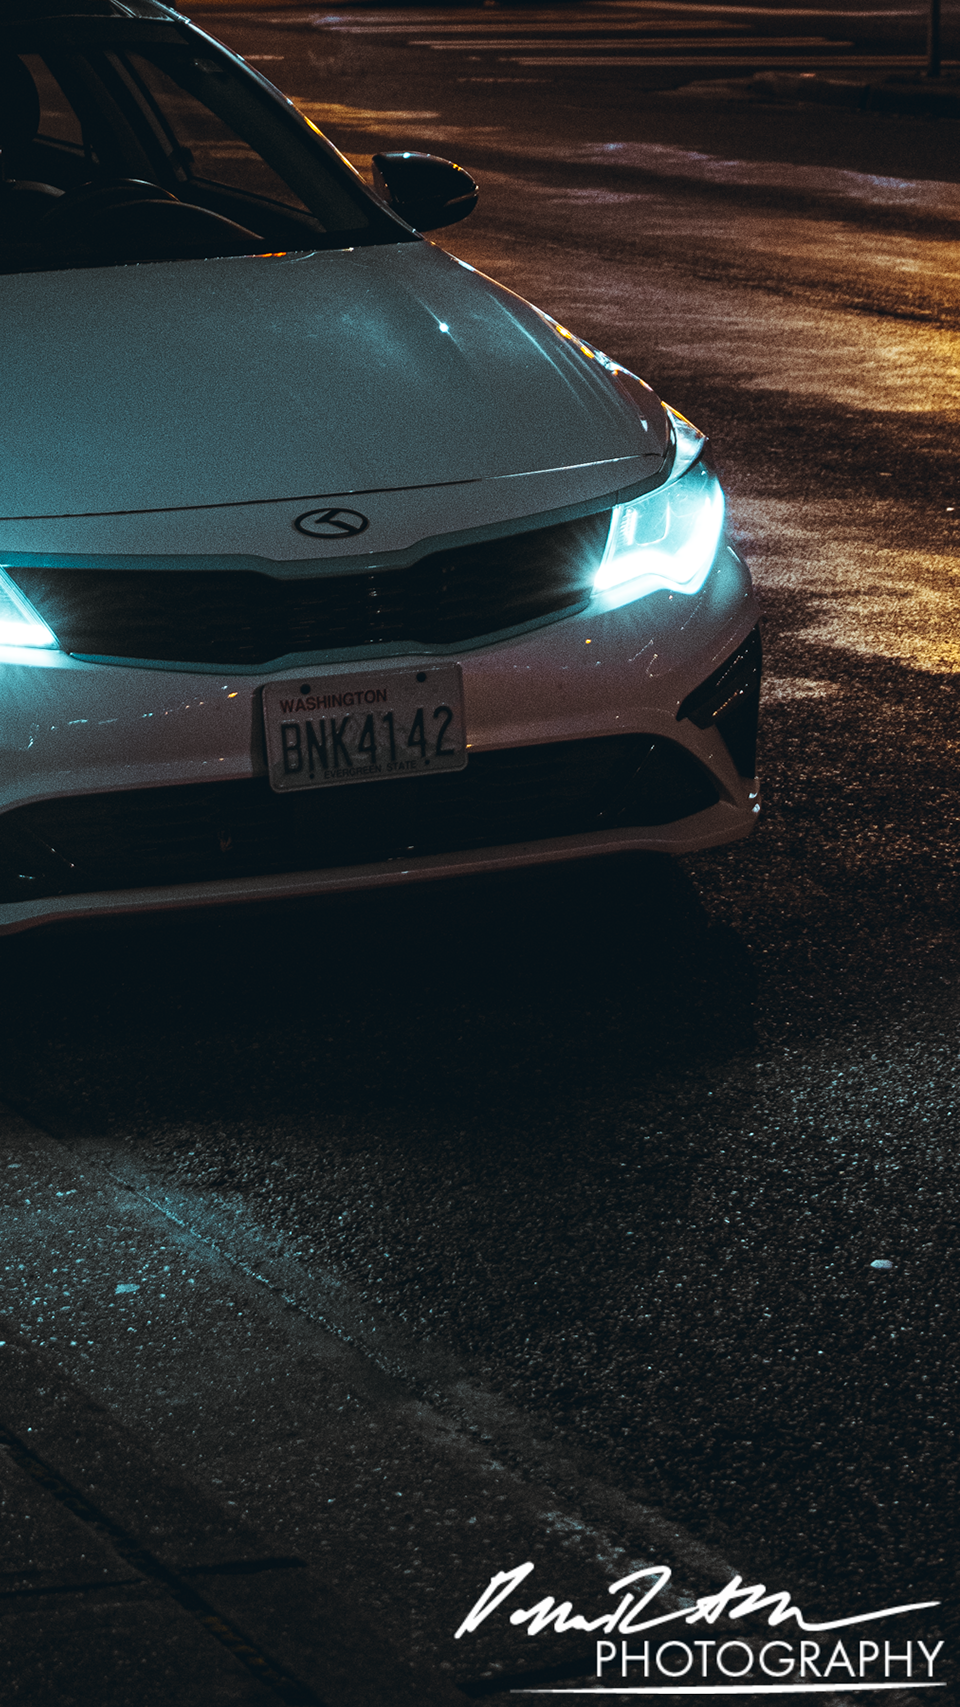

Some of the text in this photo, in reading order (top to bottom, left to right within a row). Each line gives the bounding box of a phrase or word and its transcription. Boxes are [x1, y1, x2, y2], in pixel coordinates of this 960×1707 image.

[280, 689, 388, 714] WASHINGTON
[281, 705, 455, 774] BNK4142
[324, 760, 417, 780] EVERGREEN STATE
